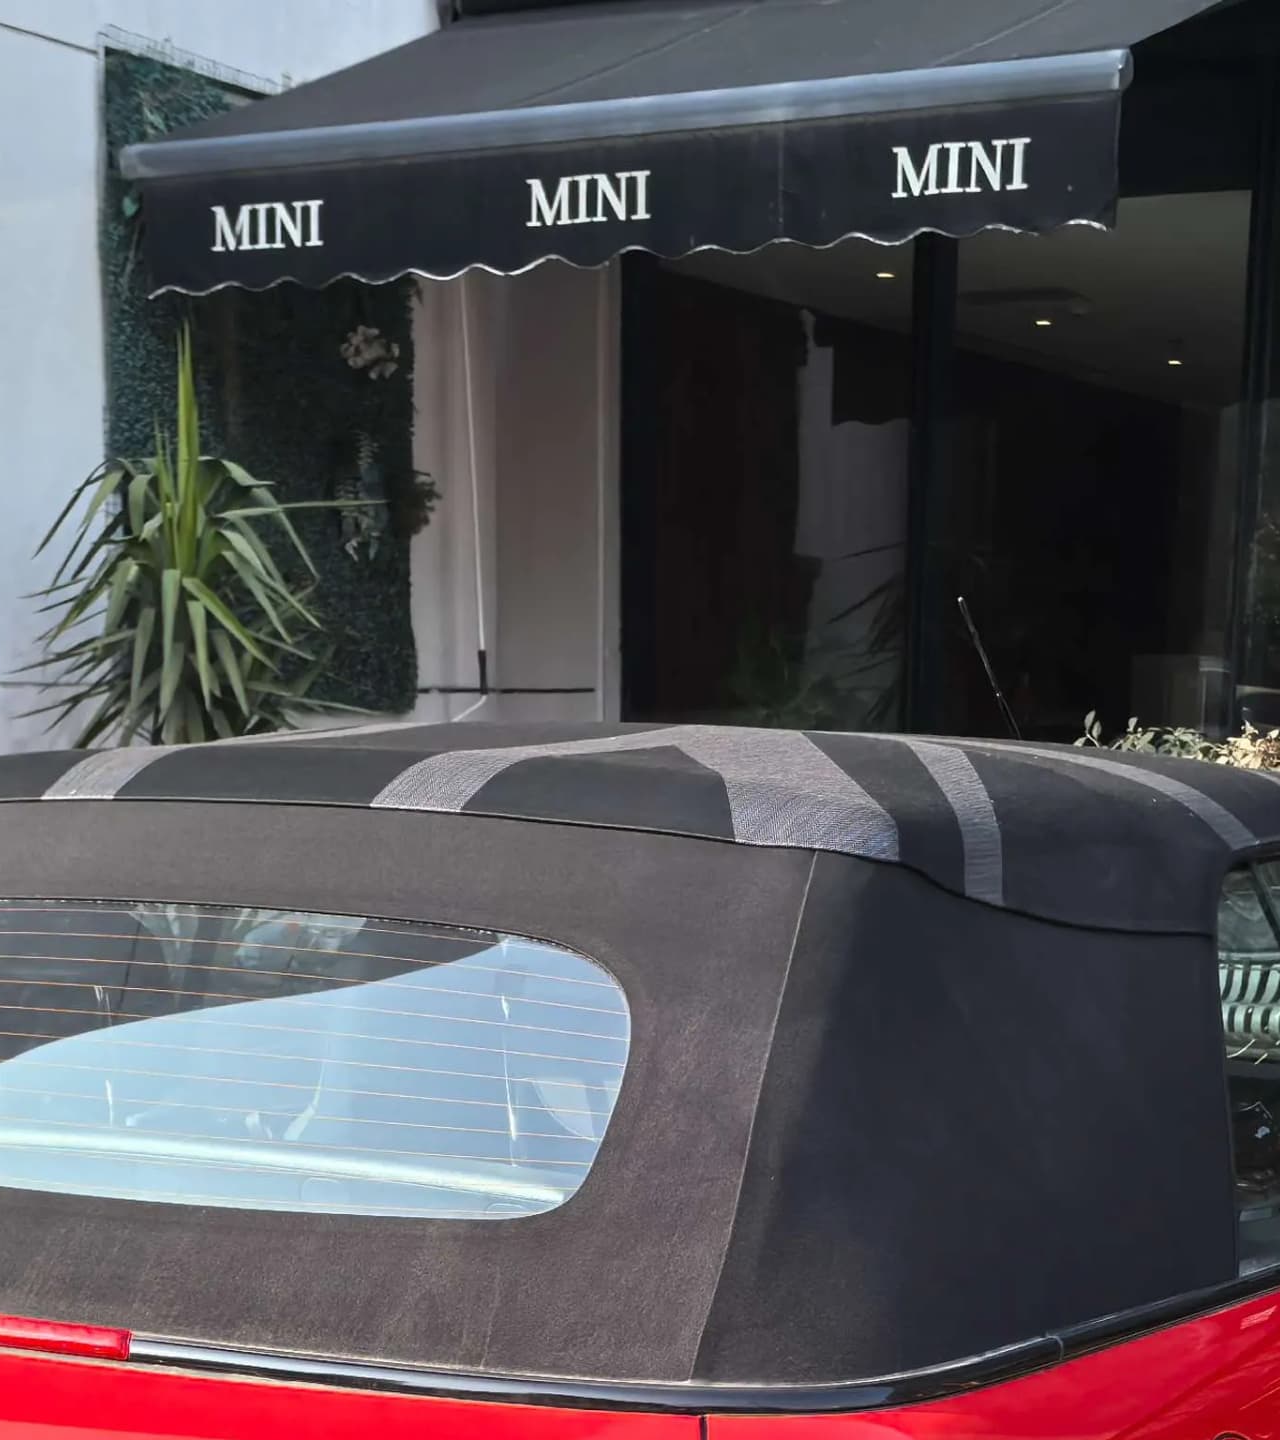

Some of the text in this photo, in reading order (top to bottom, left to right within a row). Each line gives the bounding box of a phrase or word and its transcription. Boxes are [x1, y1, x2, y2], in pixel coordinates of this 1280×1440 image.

[891, 137, 1032, 199] MINI
[211, 199, 324, 252] MINI
[525, 170, 651, 227] MINI
